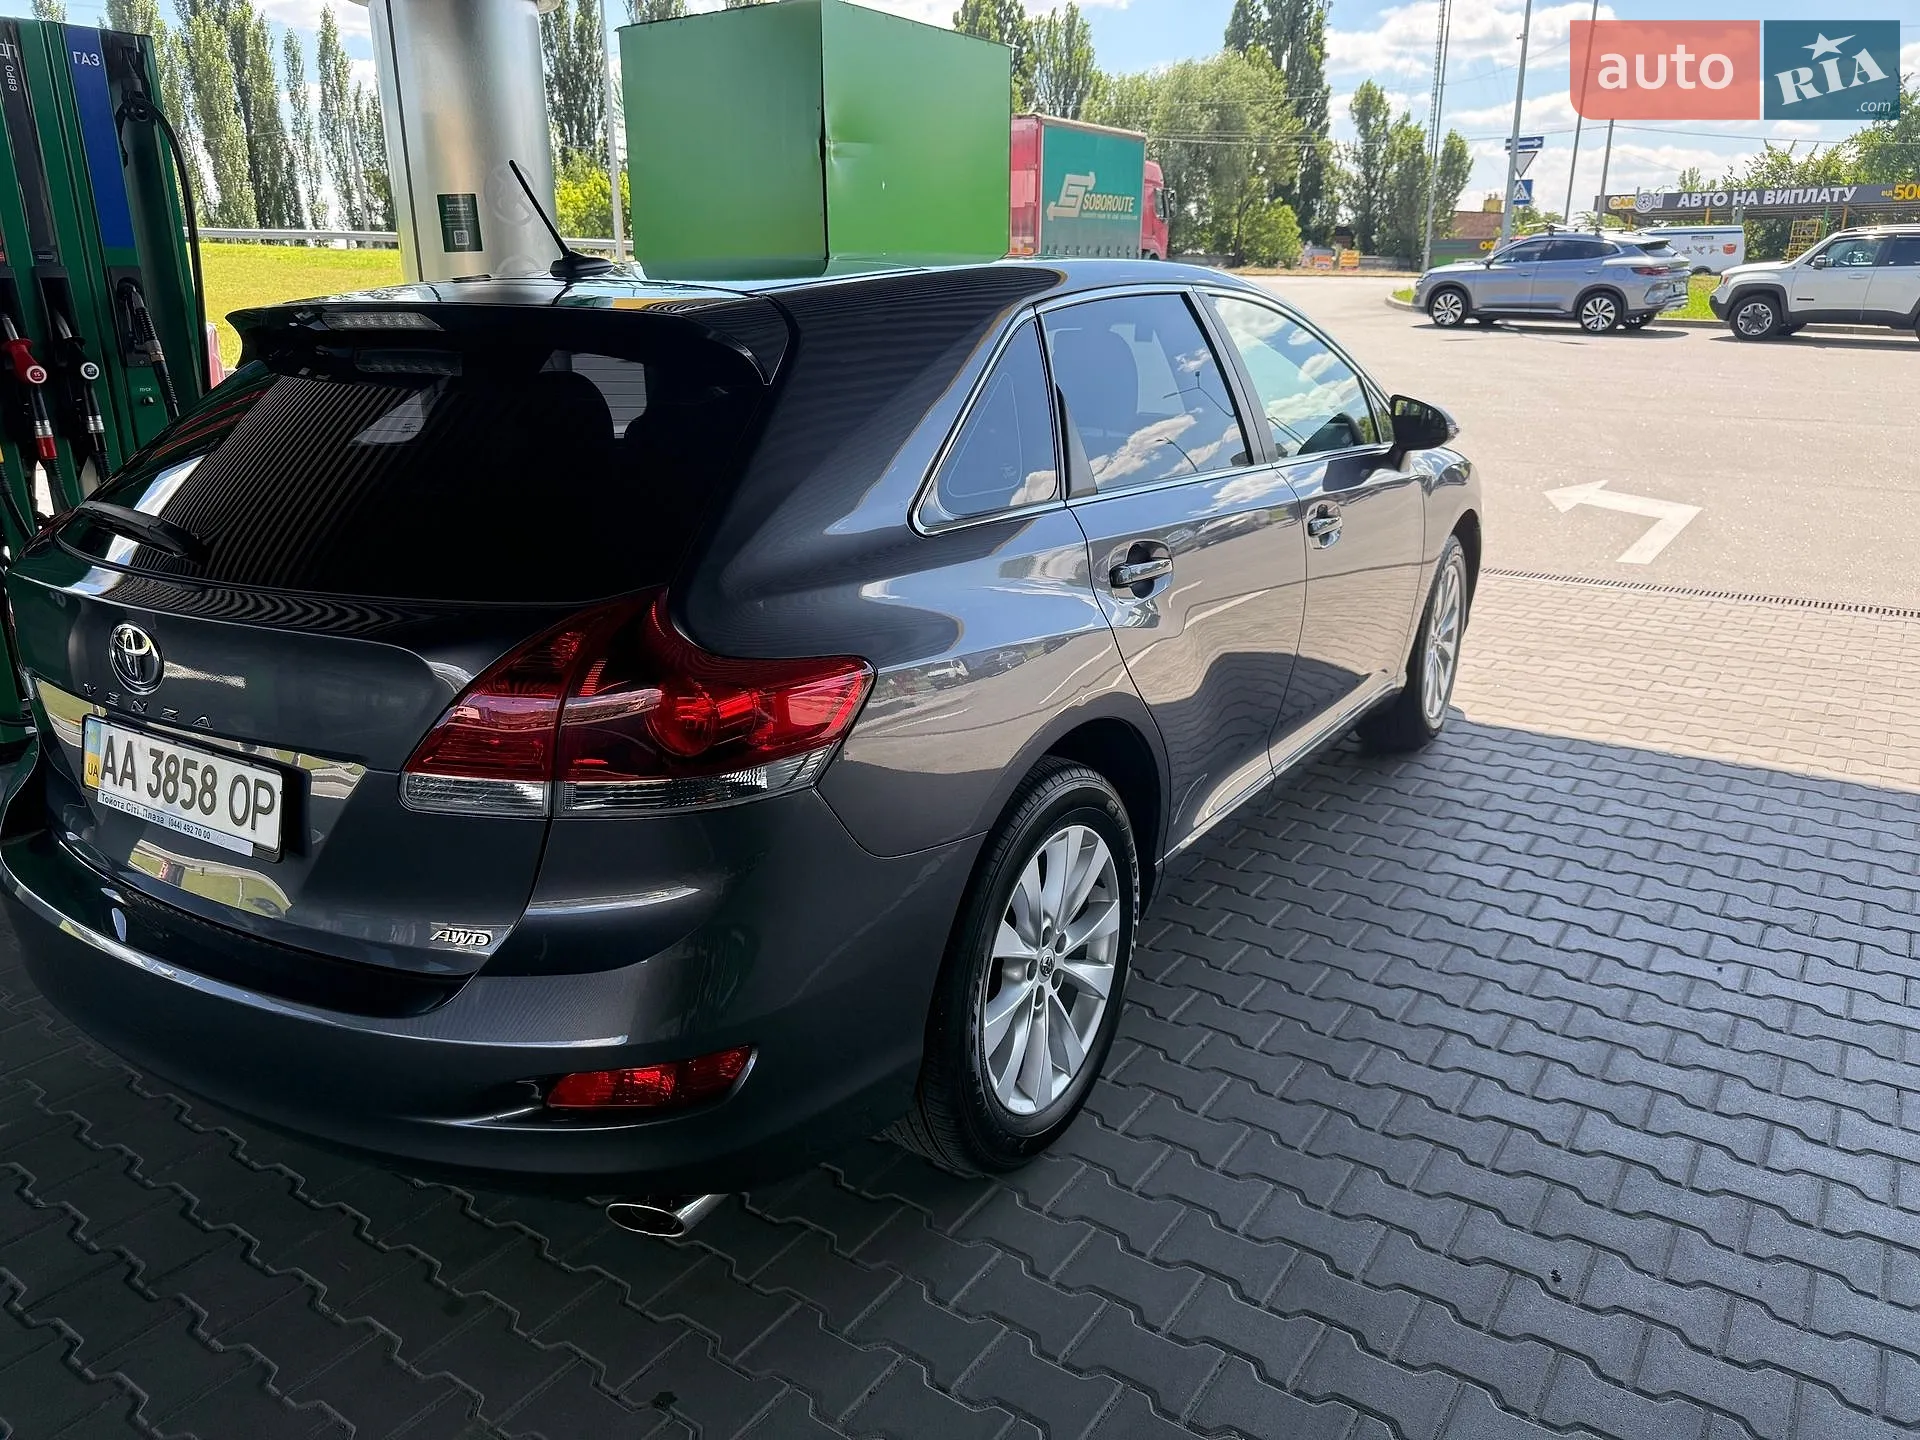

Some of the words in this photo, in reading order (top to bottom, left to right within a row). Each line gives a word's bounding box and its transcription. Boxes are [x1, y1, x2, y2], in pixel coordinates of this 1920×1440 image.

[72, 51, 100, 67] ГАЗ
[1083, 193, 1135, 213] SOBOROUTE
[1677, 191, 1729, 208] АВТО
[1731, 190, 1759, 206] НА
[1762, 186, 1858, 206] ВИПЛАТУ
[1893, 183, 1920, 201] 50
[83, 683, 213, 728] VENZA
[88, 764, 99, 778] UA
[101, 735, 137, 792] AA
[147, 748, 218, 816] 3858
[228, 774, 275, 831] OP
[429, 927, 493, 947] AWD
